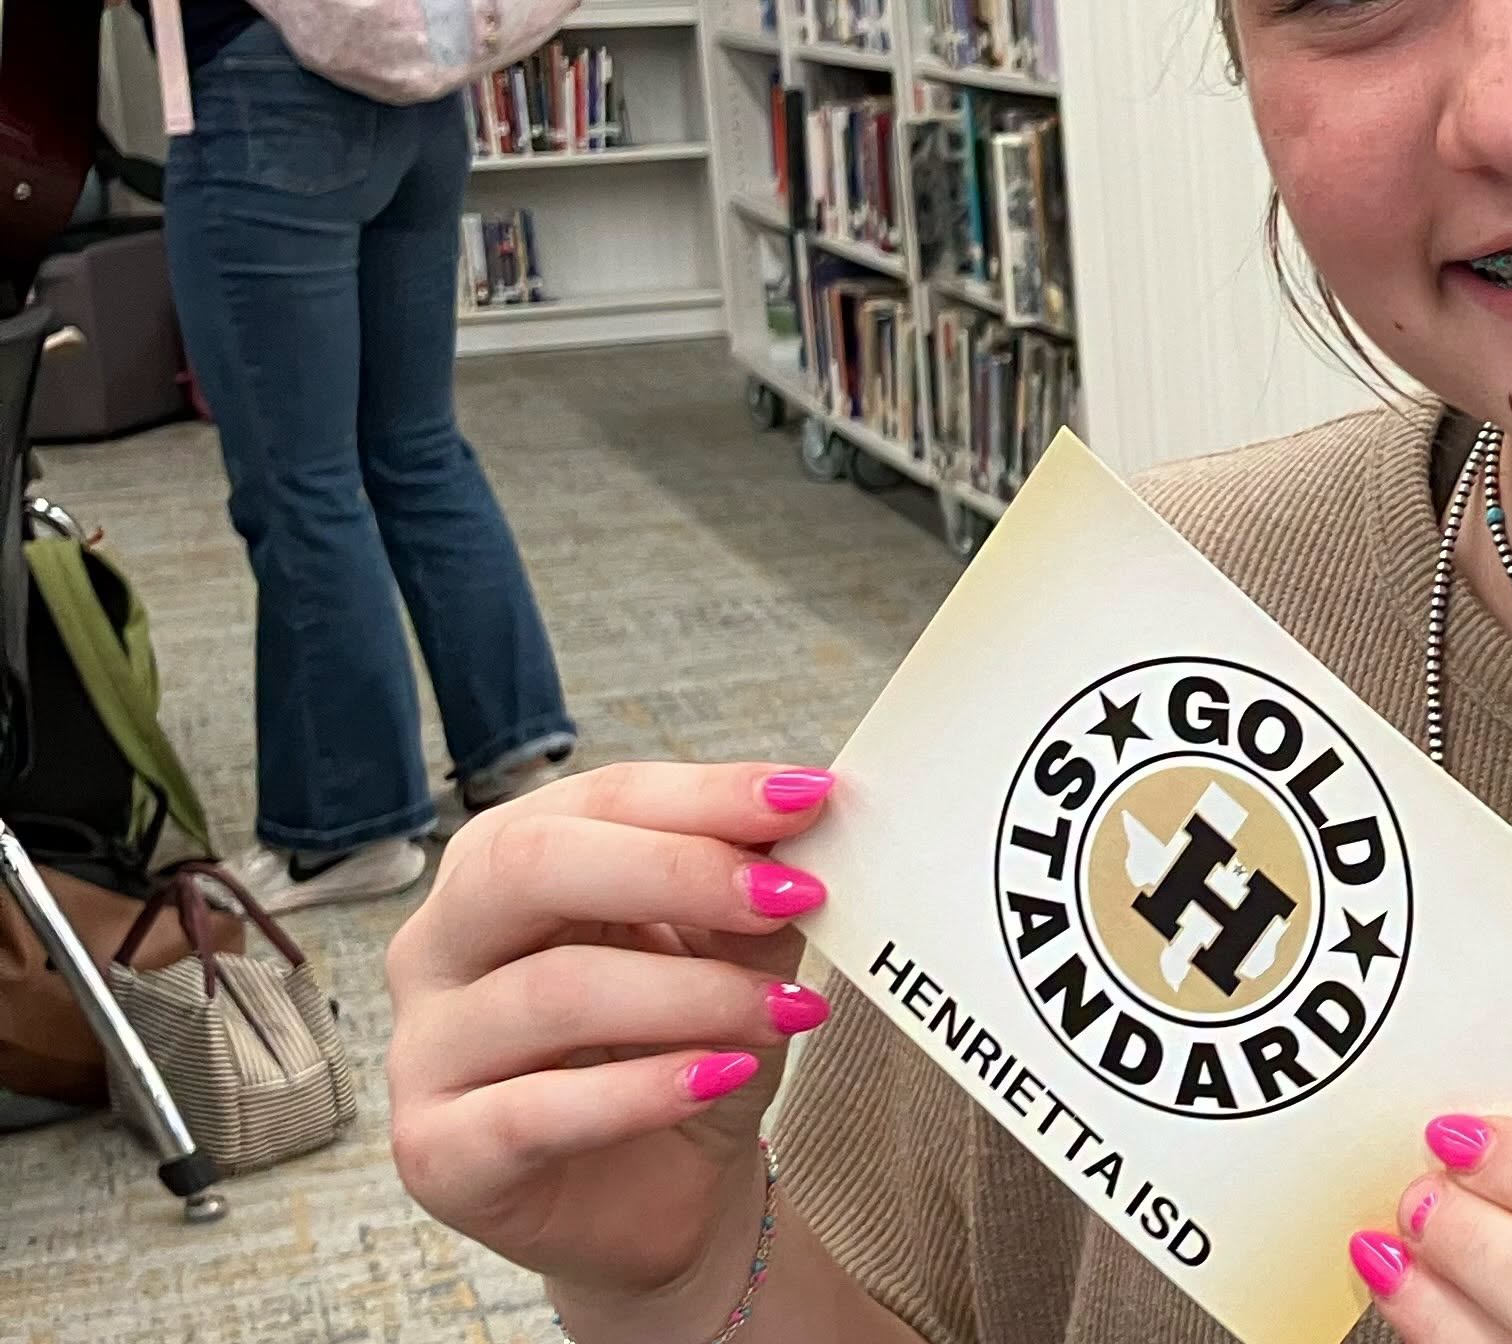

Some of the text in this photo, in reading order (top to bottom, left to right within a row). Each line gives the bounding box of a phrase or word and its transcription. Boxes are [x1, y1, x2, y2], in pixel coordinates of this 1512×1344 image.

[1131, 812, 1298, 997] H
[1167, 675, 1386, 886] GOLD
[1006, 739, 1367, 1110] STANDARD
[868, 940, 1211, 1270] HENRIETTA ISD
